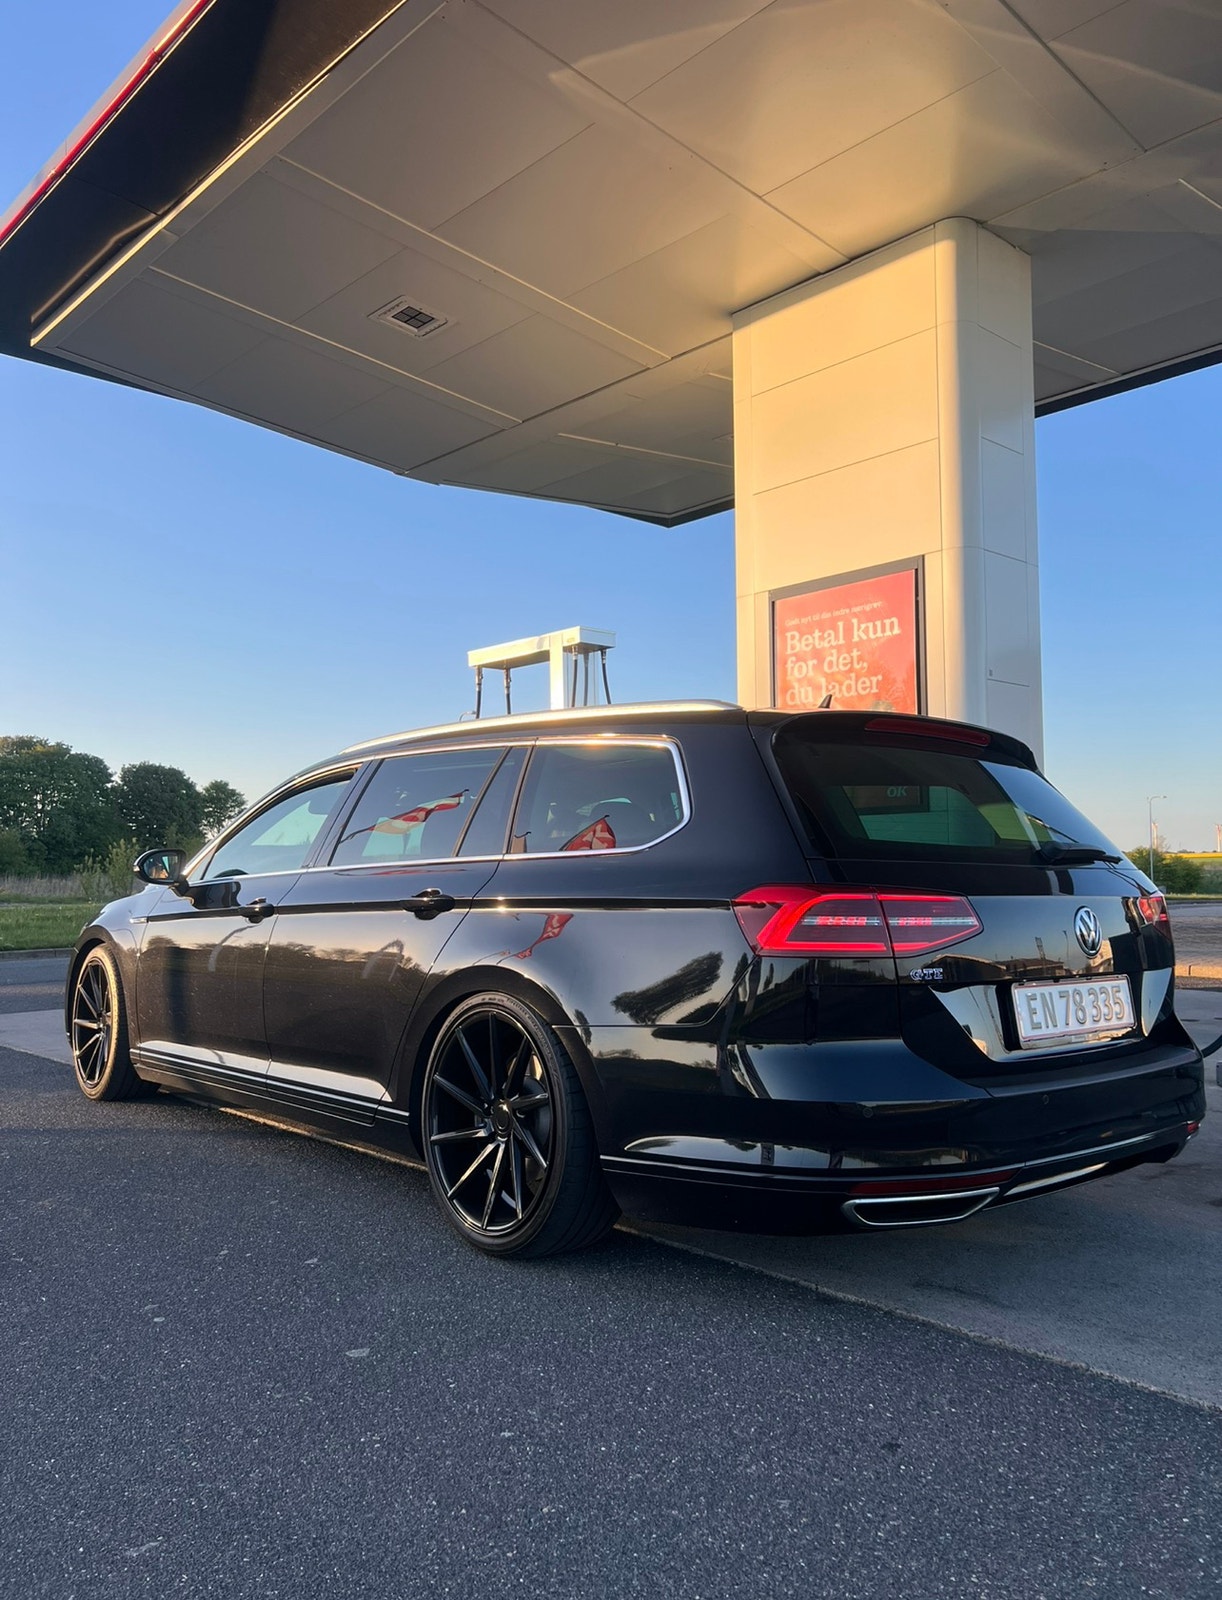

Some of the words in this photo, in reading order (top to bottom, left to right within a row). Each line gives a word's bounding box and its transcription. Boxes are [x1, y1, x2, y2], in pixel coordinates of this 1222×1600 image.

[785, 621, 845, 654] Betal
[851, 616, 901, 642] kun
[785, 656, 817, 678] for
[823, 648, 868, 673] det,
[785, 681, 813, 705] du
[820, 672, 882, 700] lader
[886, 785, 908, 798] OK
[910, 967, 944, 981] GTE
